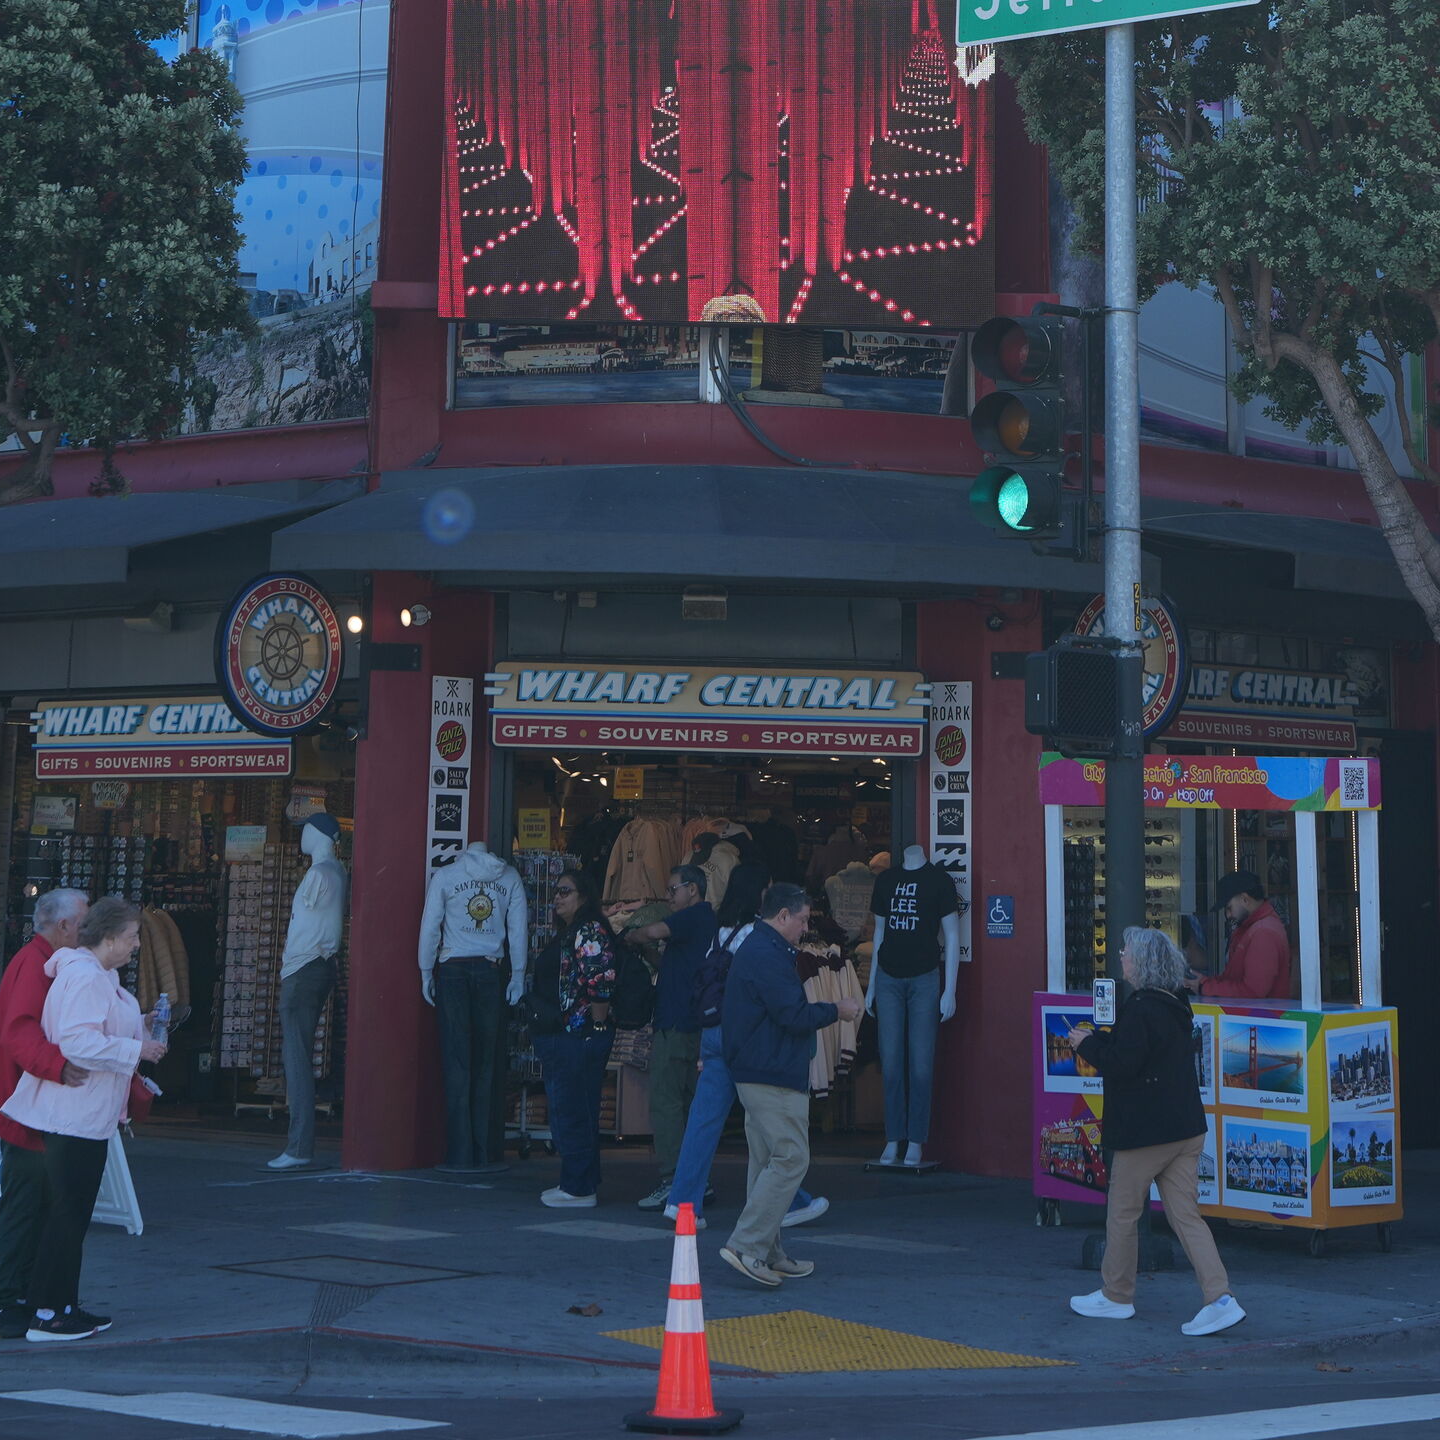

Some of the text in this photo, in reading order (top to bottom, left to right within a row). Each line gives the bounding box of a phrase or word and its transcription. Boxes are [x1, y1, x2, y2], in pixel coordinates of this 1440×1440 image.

[232, 581, 339, 652] GIFTS SOUVENIRS
[250, 597, 324, 634] WHARF
[1133, 582, 1142, 632] 276
[245, 666, 325, 706] CENTRAL
[517, 670, 898, 710] WHARF CENTRAL
[1233, 670, 1347, 709] CENTRAL
[238, 688, 329, 726] SPORTSWEAR
[434, 700, 471, 717] ROARK
[932, 706, 970, 721] ROARK
[43, 703, 251, 736] WHARF CENTRA
[436, 723, 463, 746] SANTA
[501, 724, 913, 748] GIFTS SOUVENIRS SPORTSWEAR
[935, 727, 964, 751] SANTA
[1178, 720, 1351, 742] SOUVENIRS SPORTSWEAR
[440, 738, 463, 757] CRUZ
[940, 743, 962, 763] CRUZ
[41, 754, 285, 770] GIFTS SOUVENIRS SPORTSWEAR
[448, 770, 465, 778] SALTY
[448, 778, 465, 786] CREW
[949, 774, 966, 782] SALTY
[1189, 766, 1211, 783] San
[1213, 766, 1268, 784] Francisco
[949, 782, 965, 790] CREW
[1151, 788, 1215, 802] On Hop Off
[454, 879, 507, 896] SAN FRANCISCO
[895, 881, 917, 896] HO
[890, 897, 917, 913] LEE
[889, 915, 919, 931] CHIT
